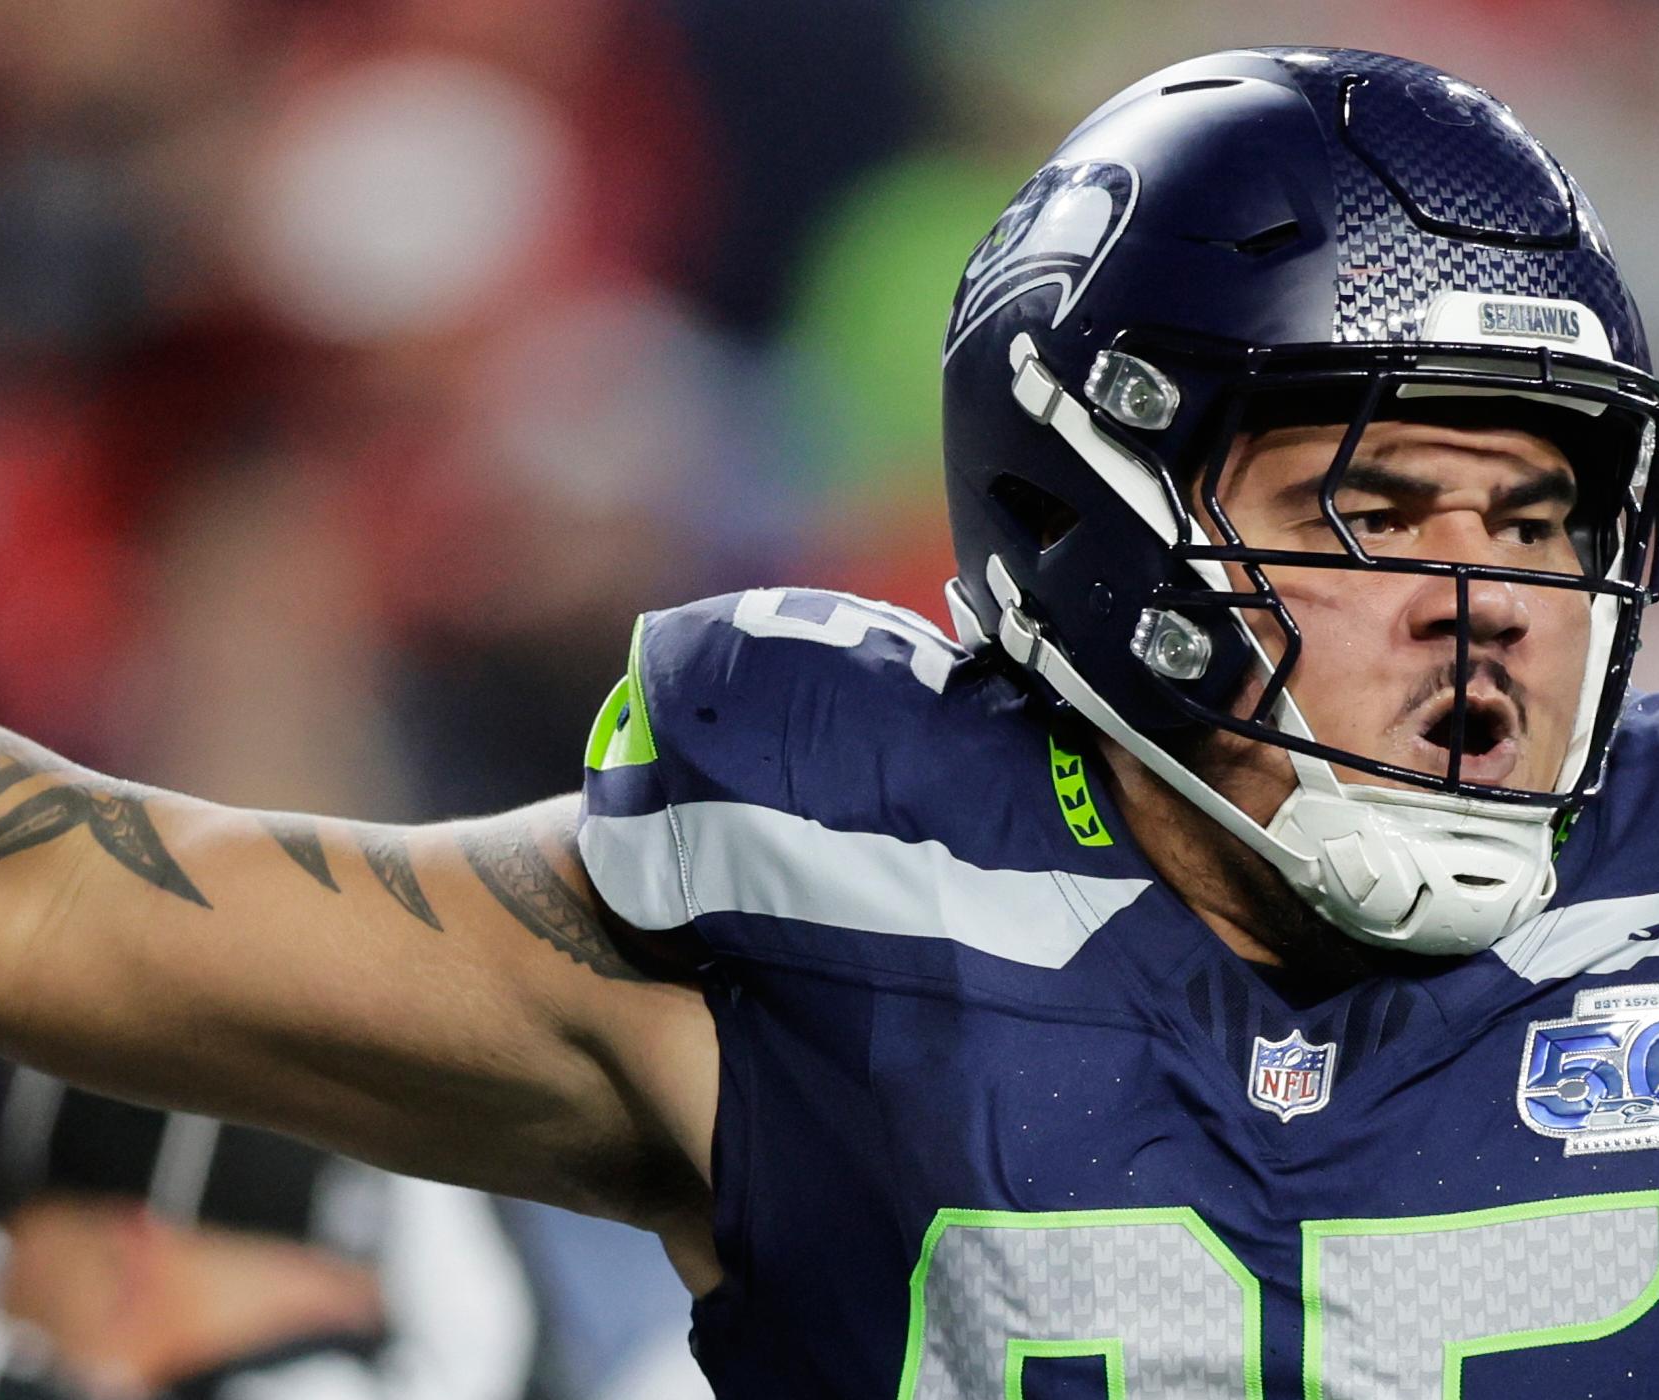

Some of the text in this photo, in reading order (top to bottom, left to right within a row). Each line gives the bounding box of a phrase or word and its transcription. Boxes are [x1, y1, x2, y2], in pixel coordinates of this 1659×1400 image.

[1483, 302, 1580, 339] SEAHAWKS
[1594, 998, 1621, 1010] EST
[1260, 1068, 1315, 1102] NFL
